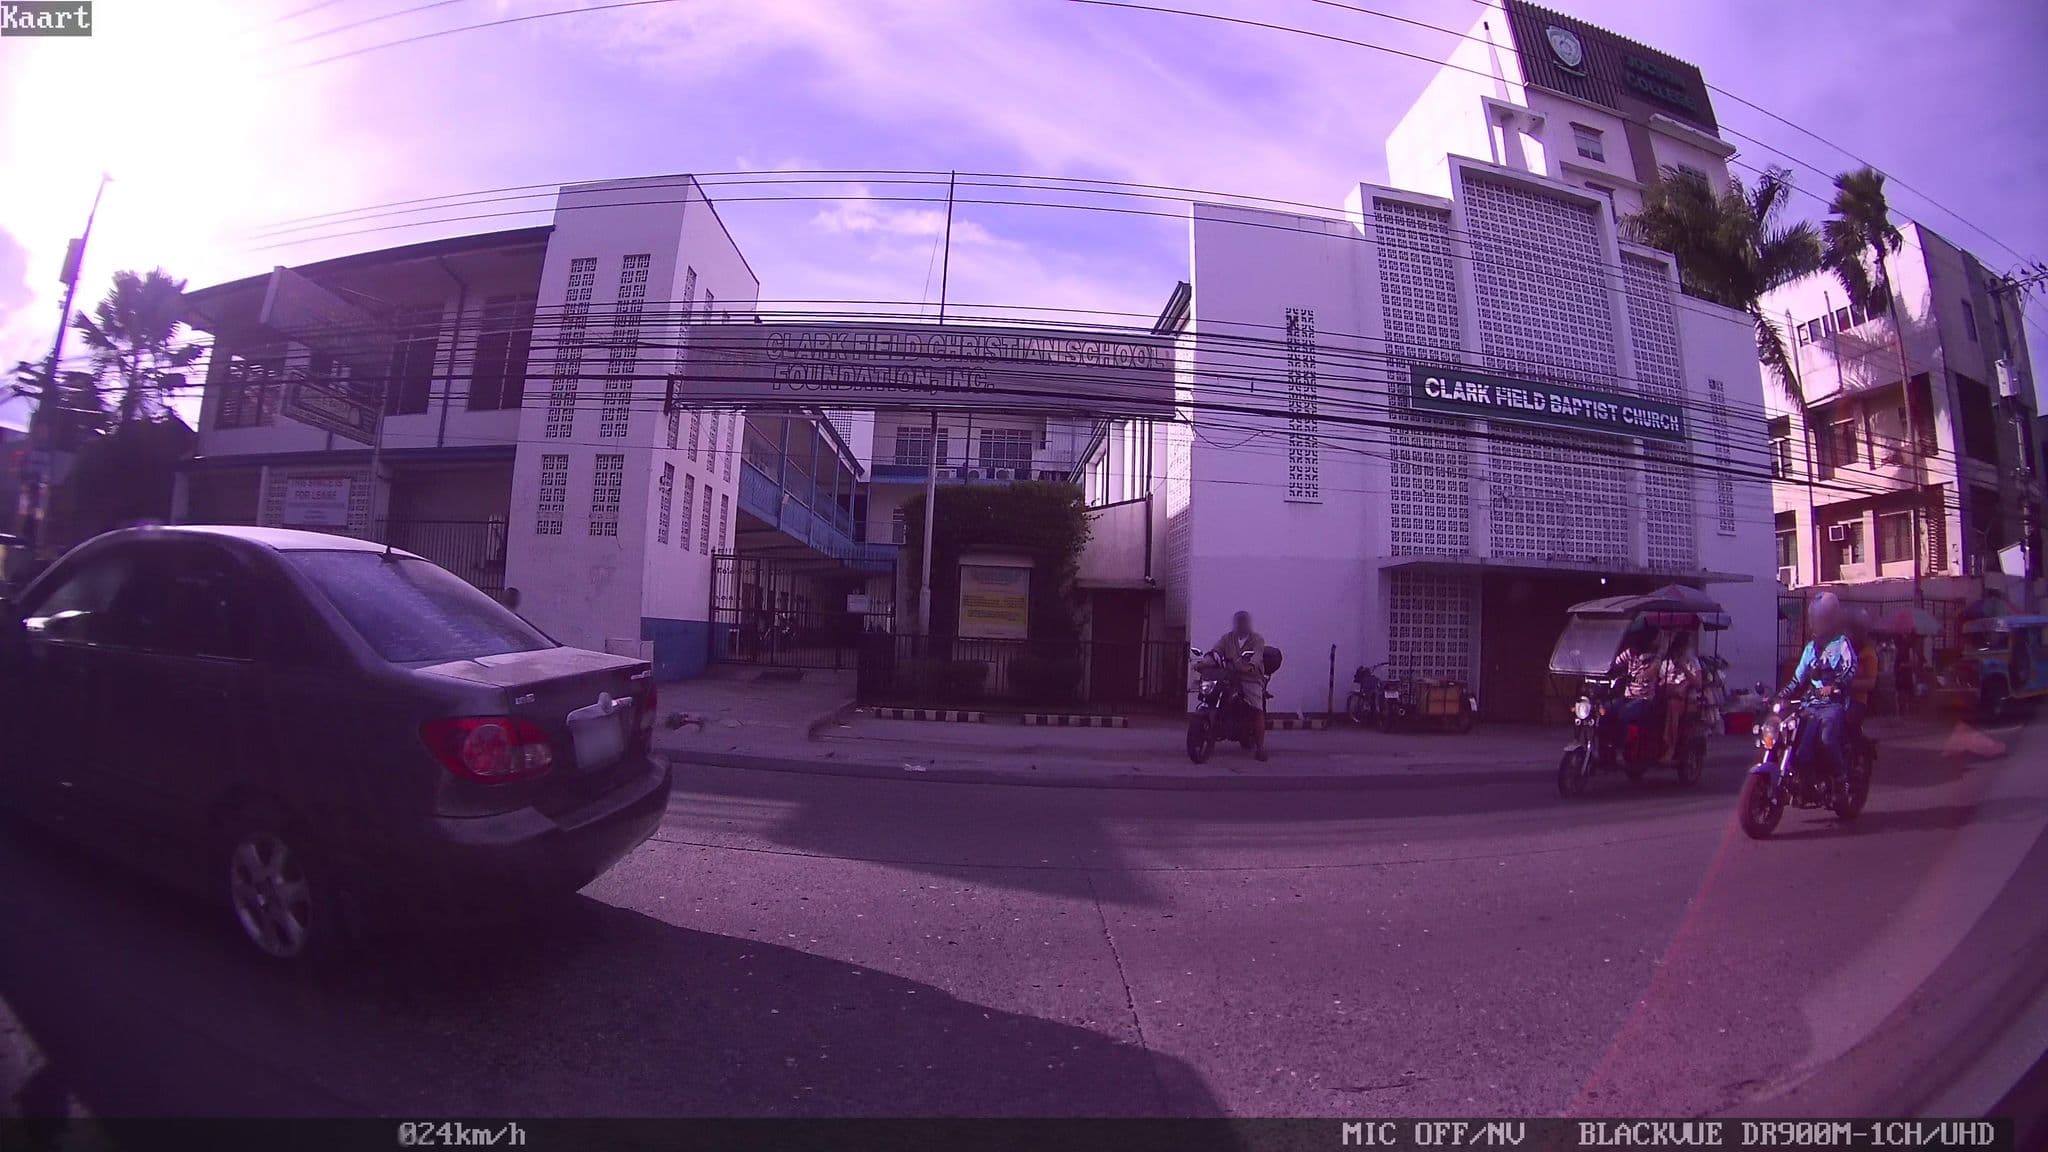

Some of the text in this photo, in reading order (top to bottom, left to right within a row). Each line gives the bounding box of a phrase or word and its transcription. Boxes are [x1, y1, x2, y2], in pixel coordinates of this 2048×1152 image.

[767, 332, 1164, 369] CLARK FIELD CHRISTIAN SCHOOL
[1424, 377, 1680, 432] CLARK FIELD BAPTIST CHURCH
